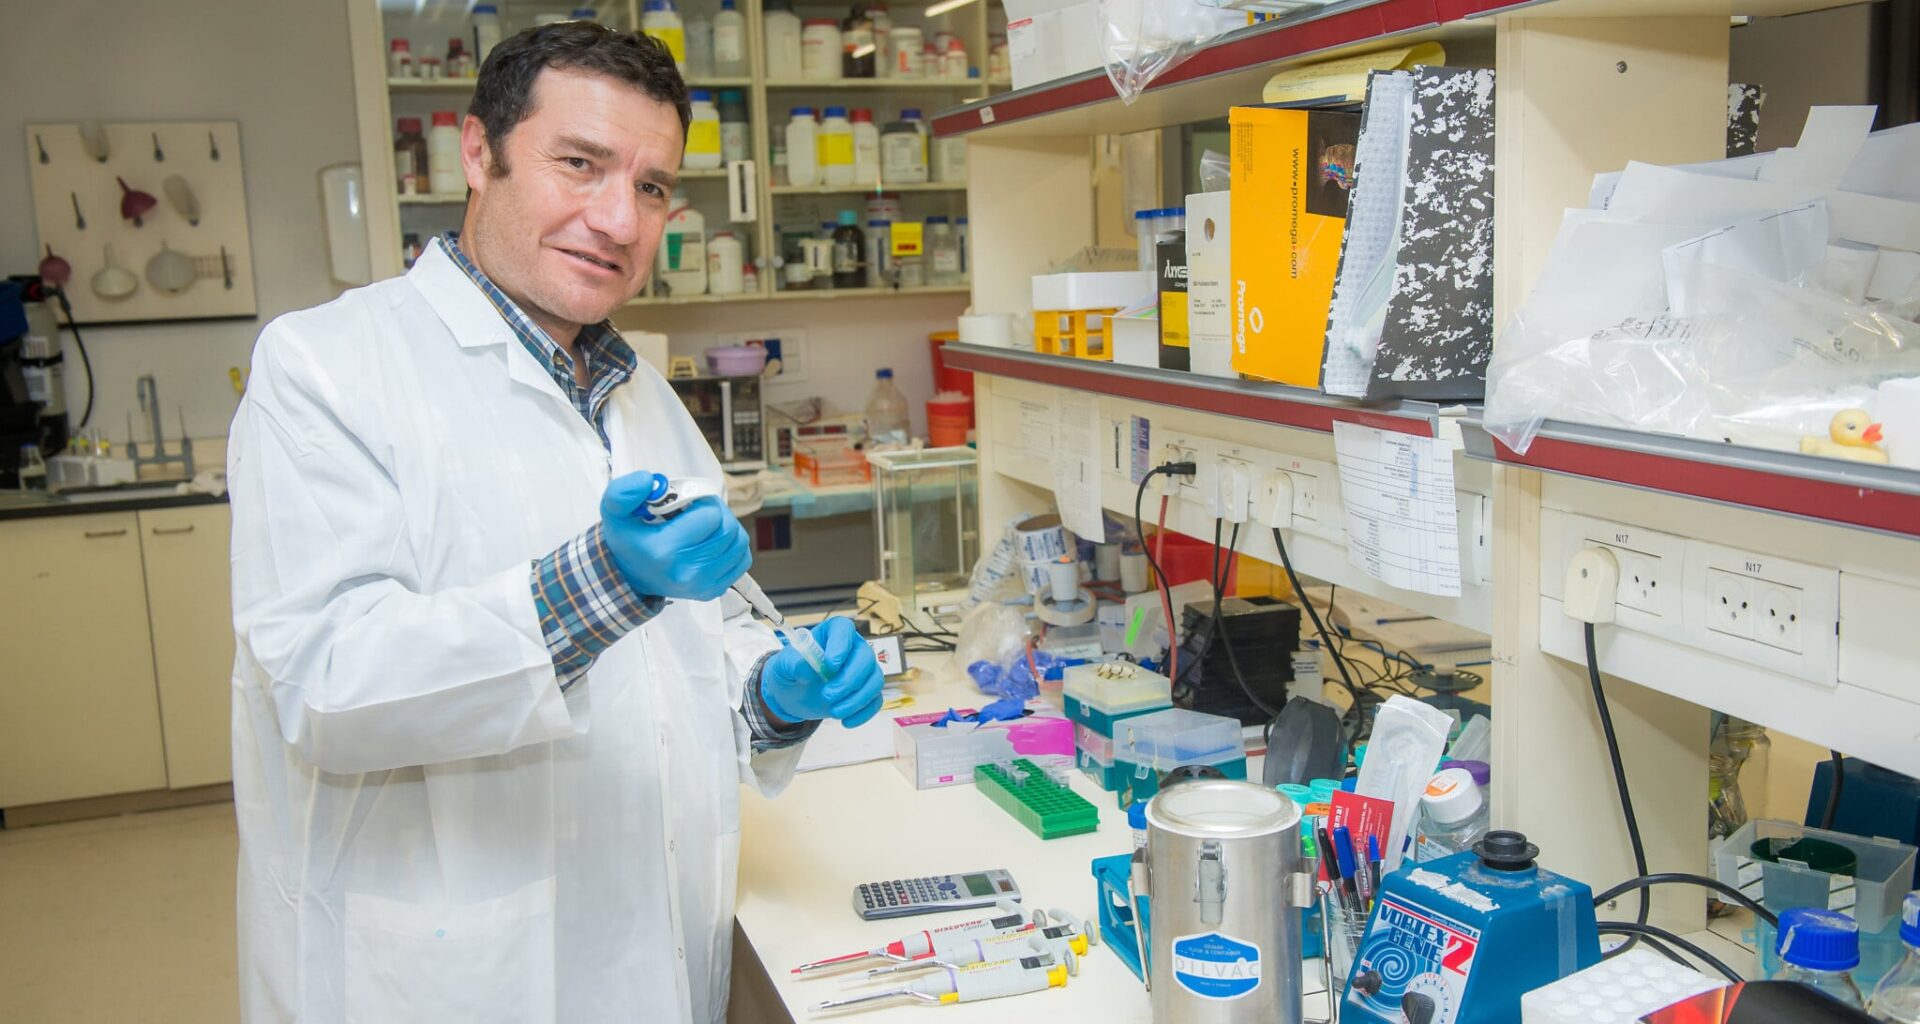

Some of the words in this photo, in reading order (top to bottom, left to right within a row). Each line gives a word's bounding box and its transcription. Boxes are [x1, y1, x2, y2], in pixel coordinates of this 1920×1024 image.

[1236, 279, 1248, 355] Promega
[1615, 533, 1629, 544] N17
[1745, 561, 1762, 573] N17
[1388, 926, 1444, 964] GENIE
[1441, 934, 1476, 976] 2
[1175, 958, 1259, 977] DILVAC
